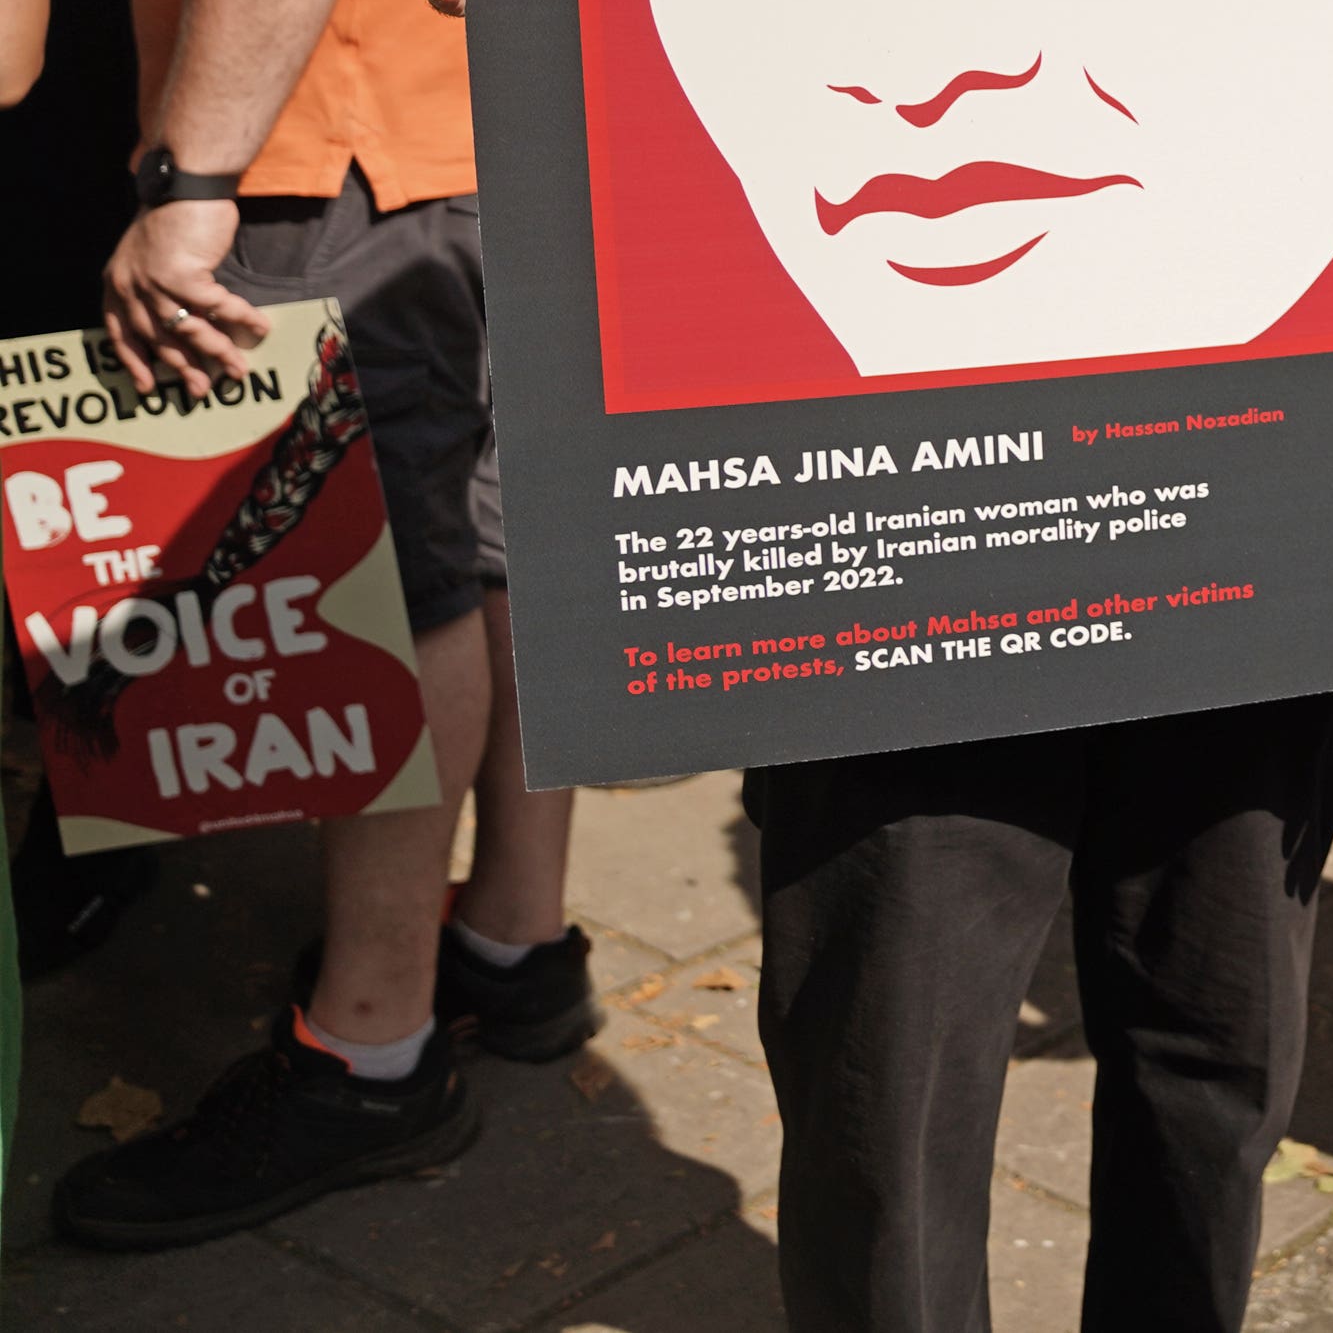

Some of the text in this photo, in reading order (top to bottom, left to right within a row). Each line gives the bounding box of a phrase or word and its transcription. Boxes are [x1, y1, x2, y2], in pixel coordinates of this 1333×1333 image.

[0, 348, 71, 387] HIS
[1072, 407, 1284, 446] by Hassan Nozadian
[614, 431, 1043, 497] MAHSA JINA AMINI
[5, 460, 132, 551] BE
[615, 483, 1209, 554] The 22 years-old Iranian woman who was
[82, 544, 162, 586] THE
[619, 509, 1186, 583] brutally killed by Iranian morality police
[621, 566, 903, 611] in September 2022.
[25, 575, 328, 686] VOICE
[624, 582, 1254, 667] To learn more about Mahsa and other victims
[627, 621, 1132, 695] of the protests, SCAN THE QR CODE.
[224, 669, 276, 705] OF
[148, 703, 376, 799] IRAN
